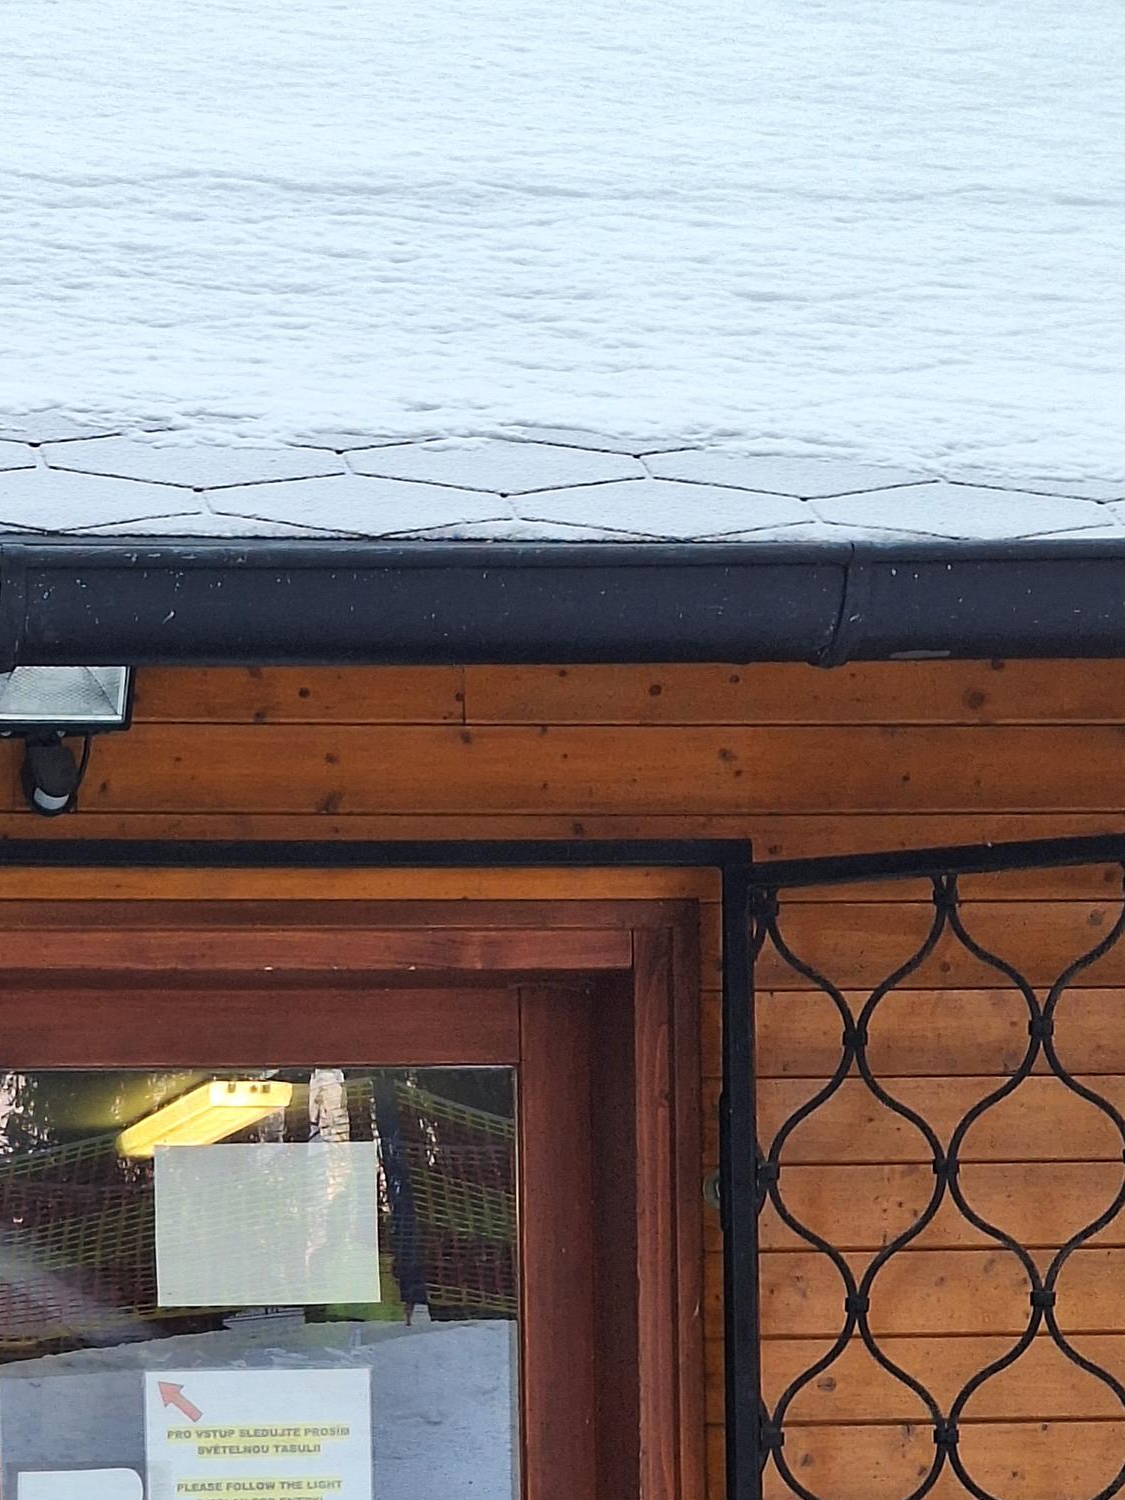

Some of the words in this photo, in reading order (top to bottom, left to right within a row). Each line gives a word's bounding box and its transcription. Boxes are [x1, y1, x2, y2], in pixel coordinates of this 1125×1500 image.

[167, 1429, 192, 1439] PRO
[195, 1428, 235, 1439] VSTUP
[239, 1427, 300, 1438] SLEDUJTE
[177, 1481, 222, 1492] PLEASE
[226, 1480, 275, 1491] FOLLOW
[279, 1480, 302, 1490] THE
[306, 1479, 343, 1490] LIGHT
